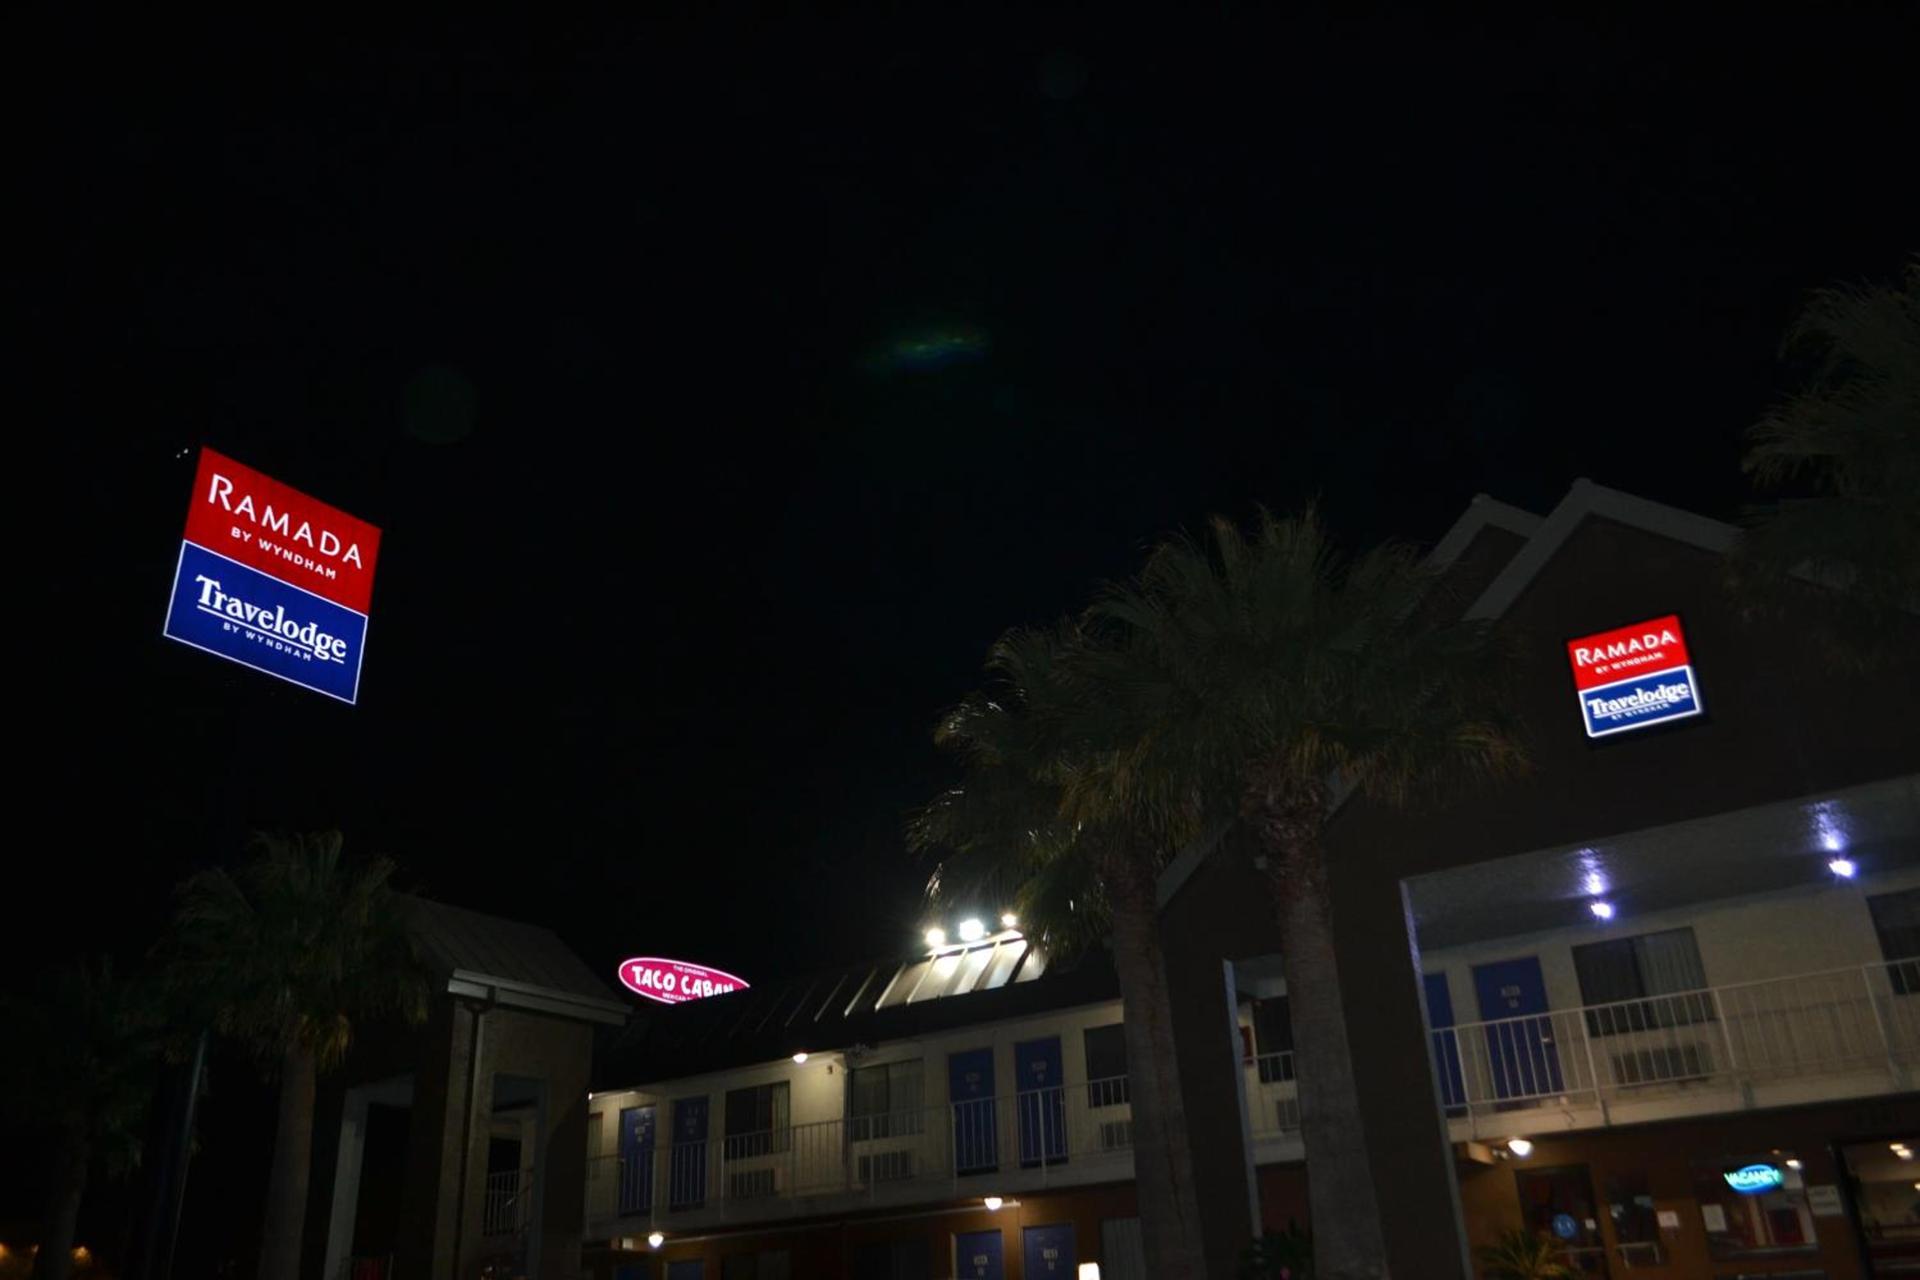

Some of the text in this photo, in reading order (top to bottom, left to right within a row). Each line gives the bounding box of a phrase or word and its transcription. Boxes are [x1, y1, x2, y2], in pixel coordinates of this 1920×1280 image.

[231, 526, 337, 580] BY WYNDHAM
[195, 574, 347, 661] Travelodge
[223, 621, 312, 662] BY WYNDHAM
[1595, 652, 1664, 674] BY WYNDHAM
[1587, 683, 1690, 715] Travelodge
[631, 965, 676, 992] TACO
